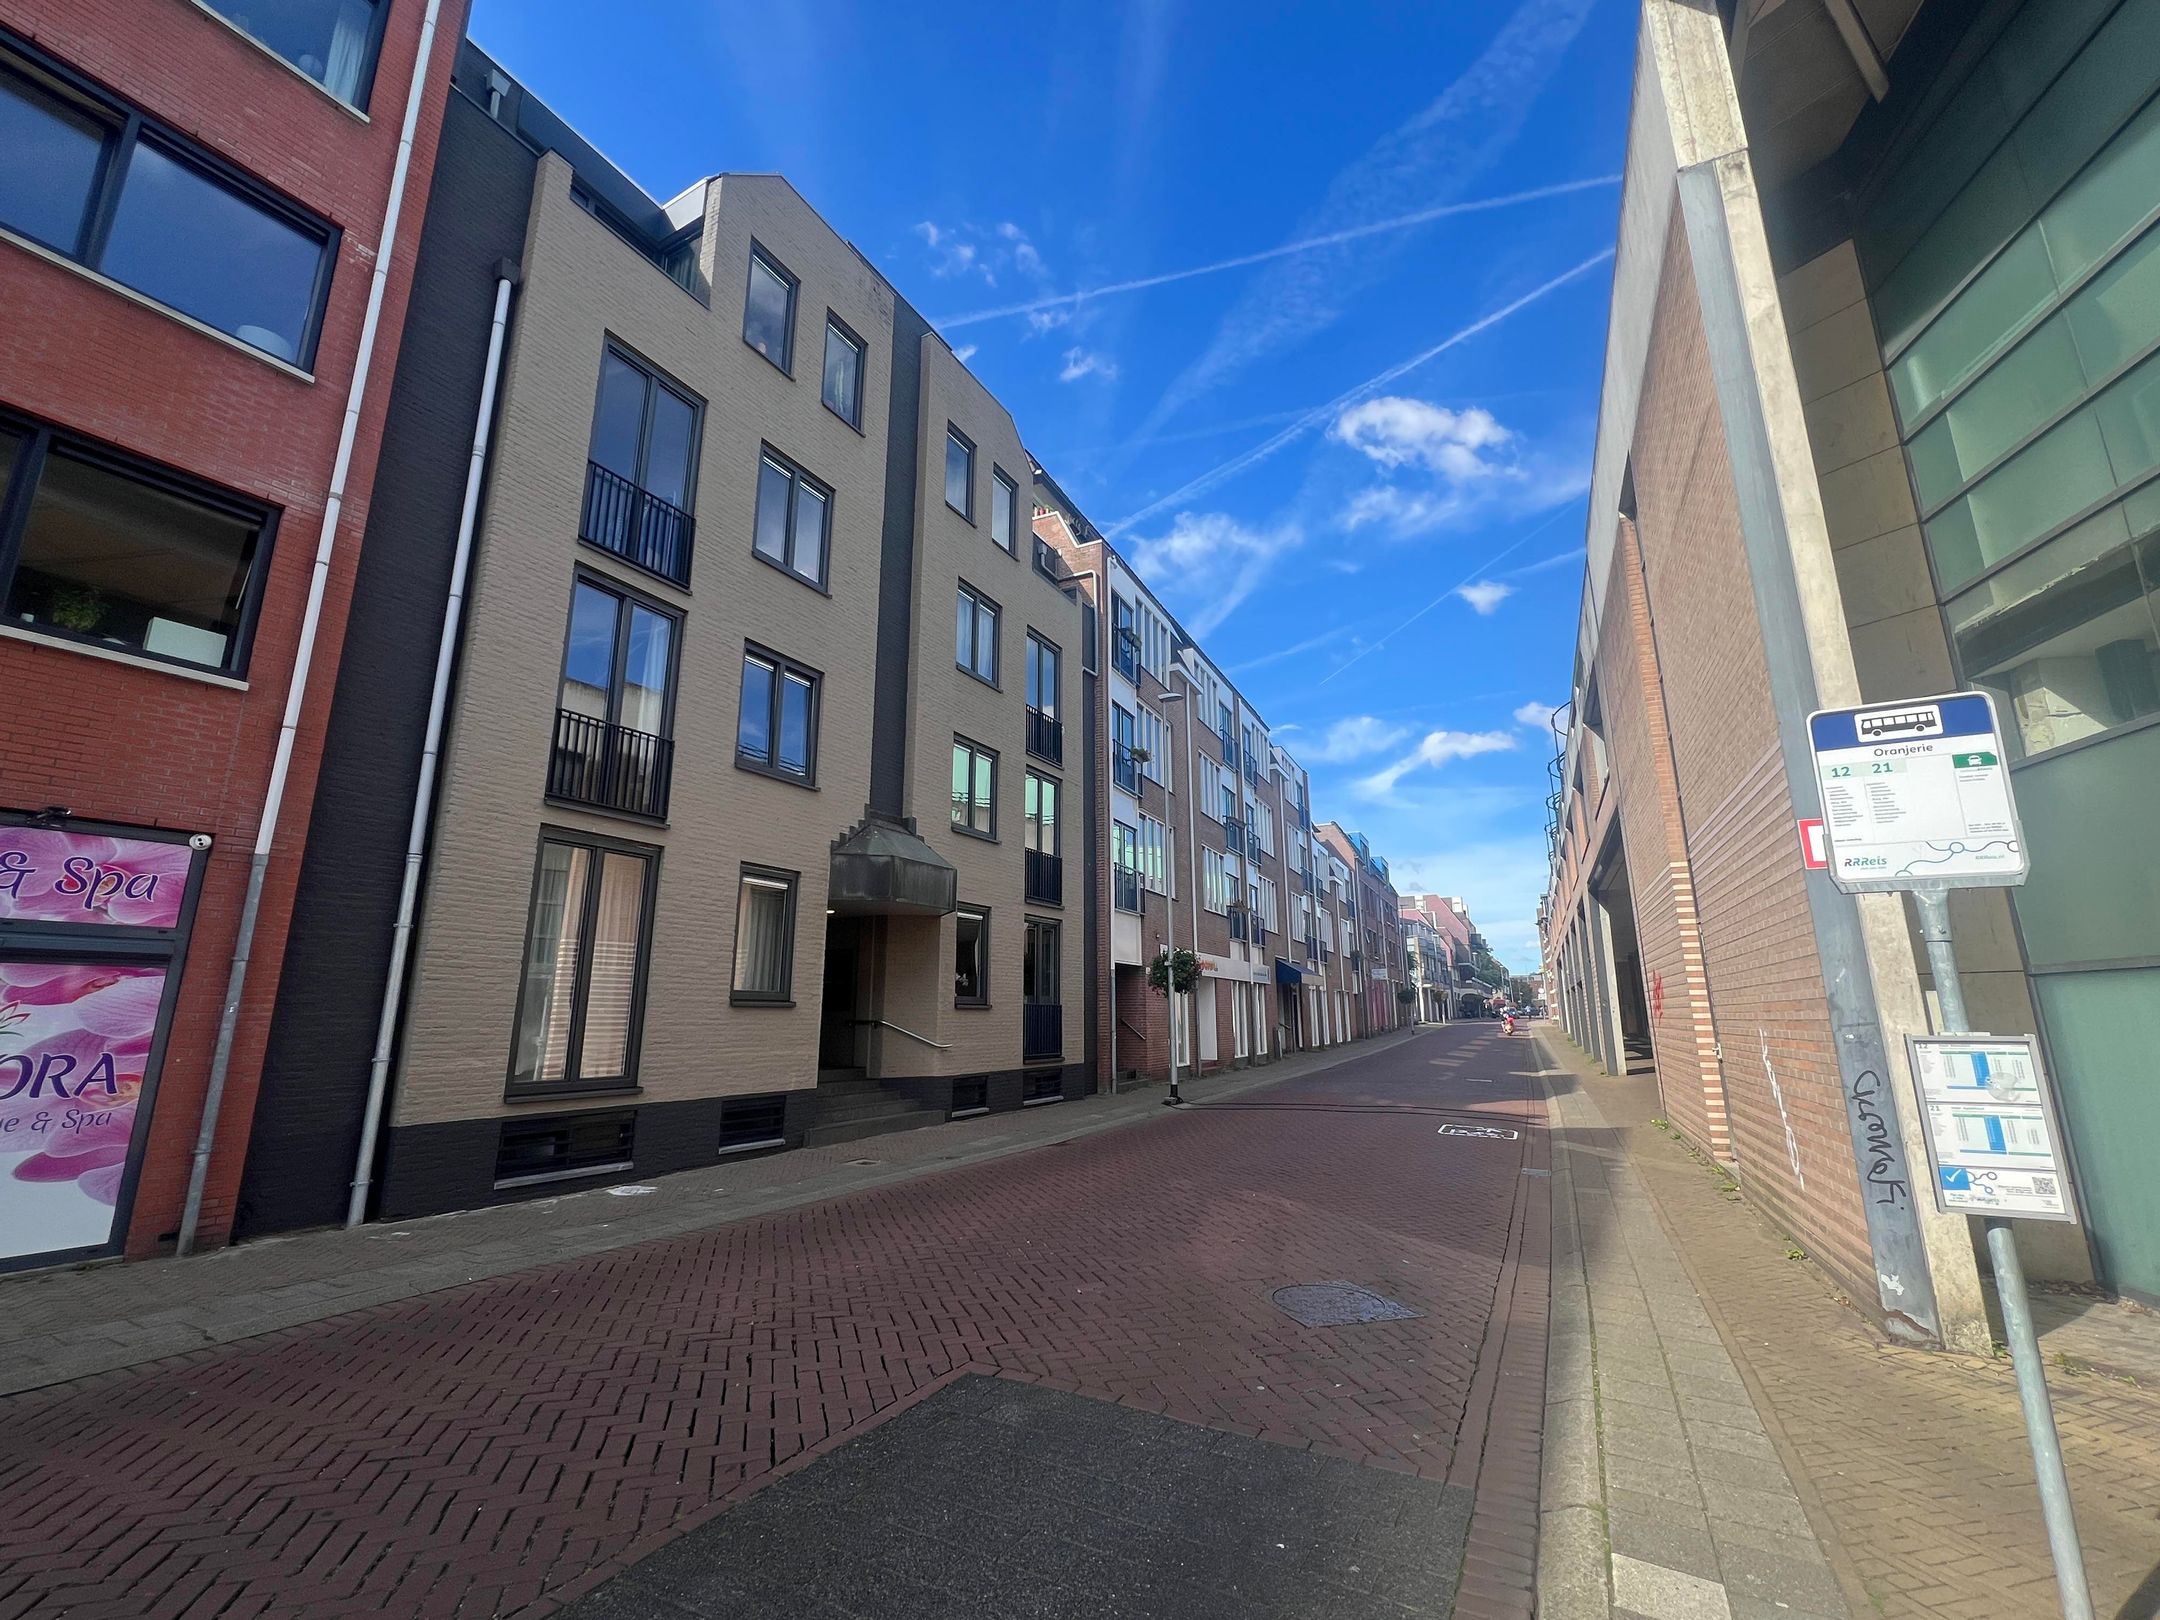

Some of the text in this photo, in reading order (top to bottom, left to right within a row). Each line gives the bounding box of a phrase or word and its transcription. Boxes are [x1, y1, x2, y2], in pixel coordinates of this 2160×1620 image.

[1874, 743, 1933, 757] Oranjerie
[1831, 762, 1893, 778] 12 21
[1844, 855, 1887, 867] RRReis
[0, 851, 159, 910] & Spa
[0, 1052, 118, 1100] ORA
[31, 1111, 53, 1134] &
[61, 1108, 112, 1135] Spa
